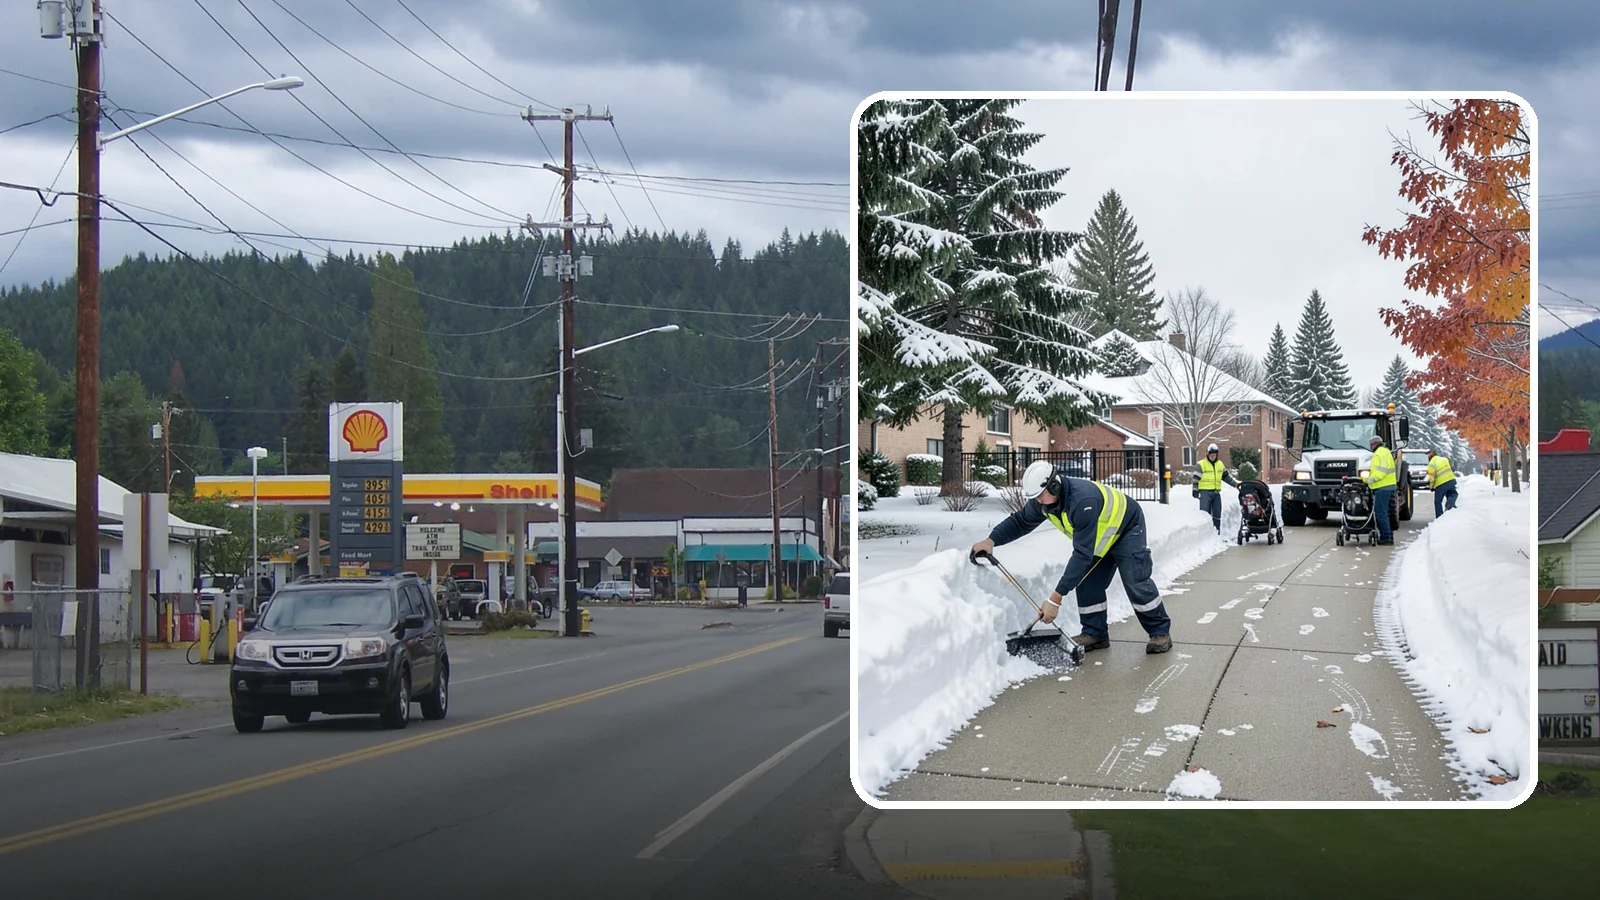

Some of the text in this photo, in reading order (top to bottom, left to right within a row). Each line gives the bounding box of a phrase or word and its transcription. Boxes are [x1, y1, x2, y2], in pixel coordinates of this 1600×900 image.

[366, 480, 383, 490] 395
[490, 484, 547, 499] Shell
[366, 494, 383, 504] 405
[366, 508, 383, 518] 415
[366, 522, 383, 532] 429
